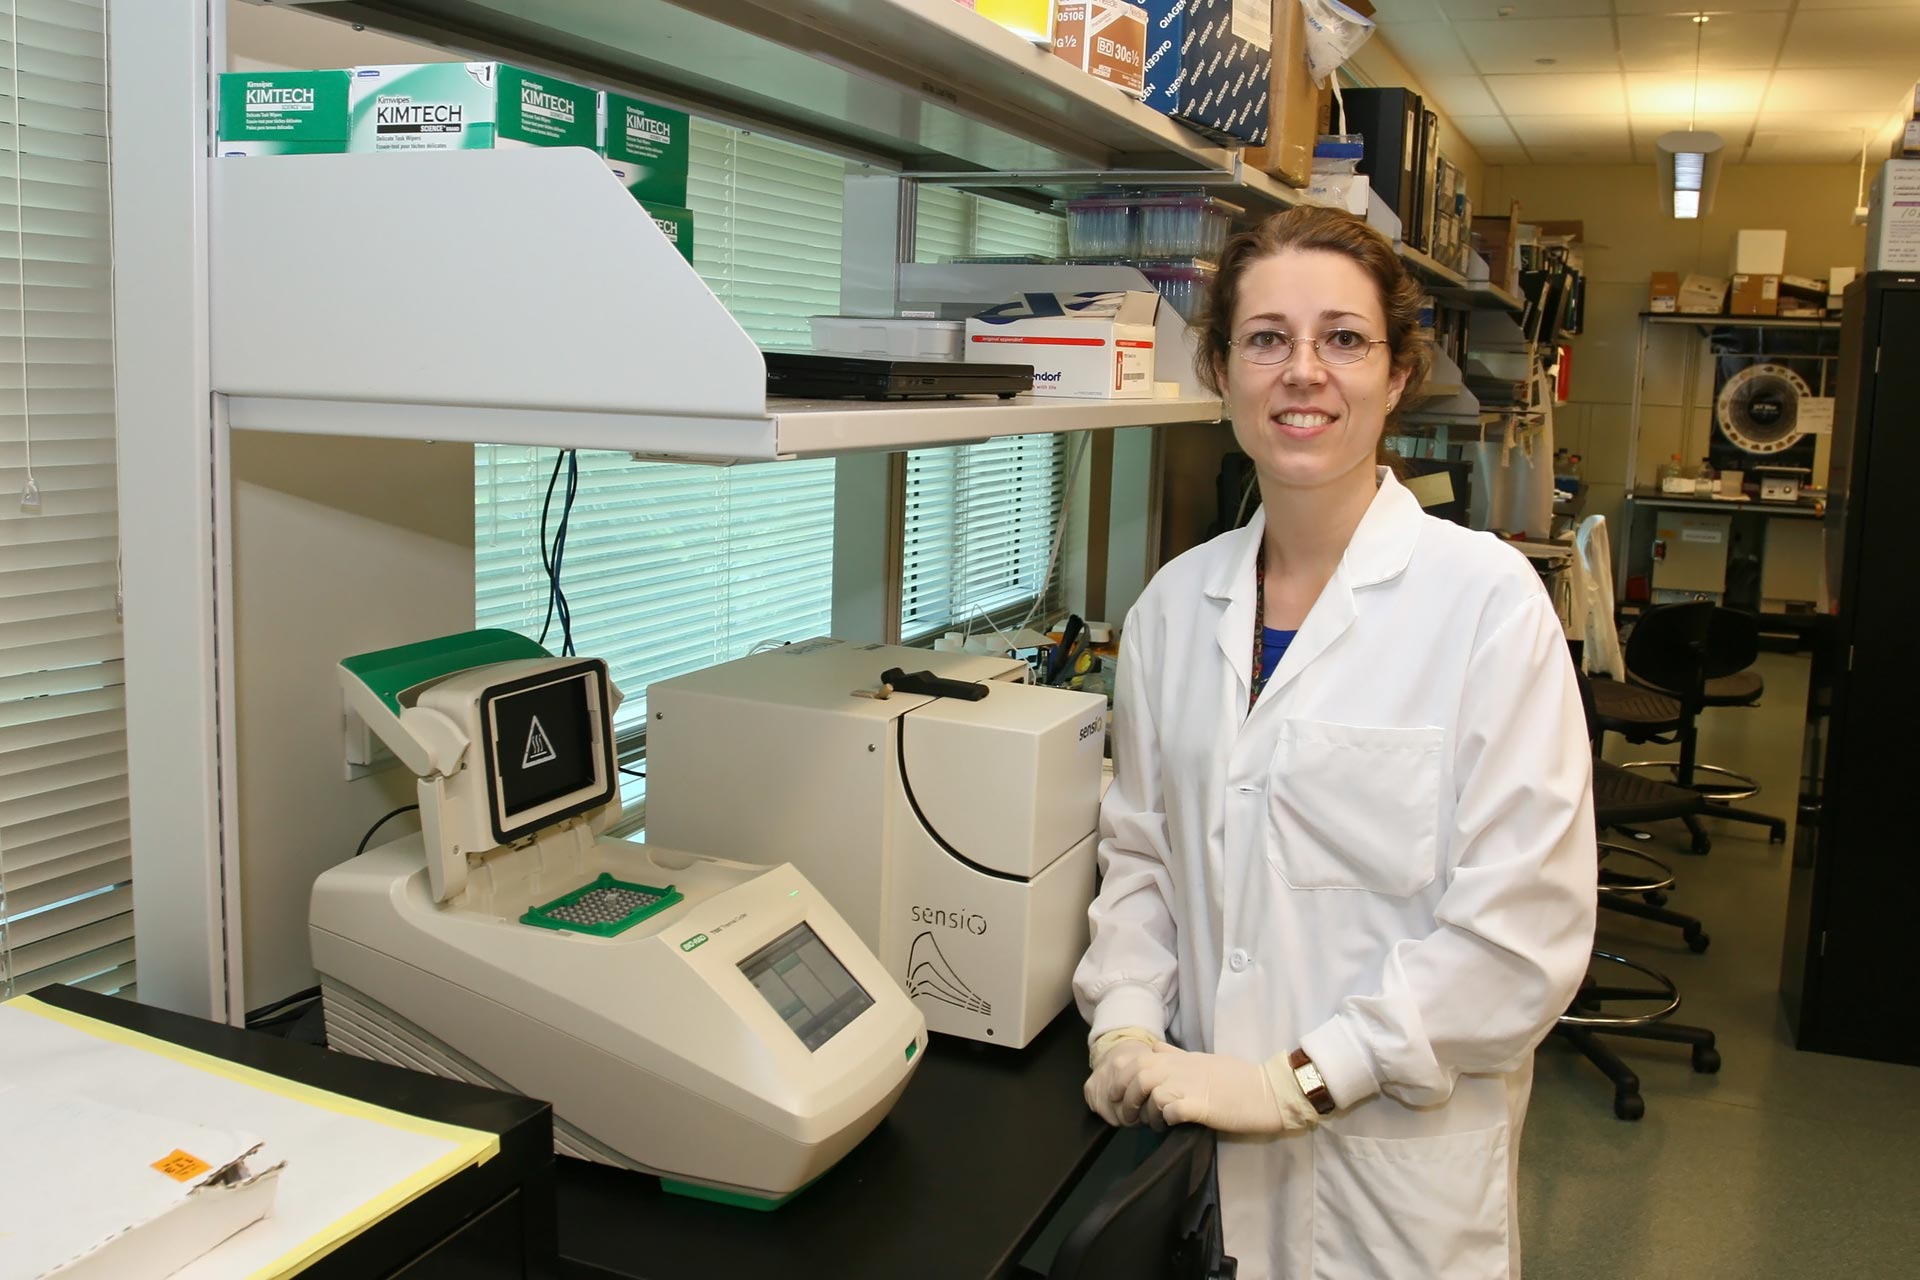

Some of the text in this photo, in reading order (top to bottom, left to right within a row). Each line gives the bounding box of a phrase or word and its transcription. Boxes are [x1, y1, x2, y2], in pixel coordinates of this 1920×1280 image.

[1144, 40, 1172, 72] QIAGEN
[246, 88, 315, 103] KIMTECH
[378, 96, 409, 104] Kimwipes
[521, 88, 574, 115] KIMTECH
[377, 105, 462, 123] KIMTECH
[626, 113, 670, 136] KIMTECH
[1033, 371, 1061, 382] ndorf
[911, 905, 987, 935] sensiQ
